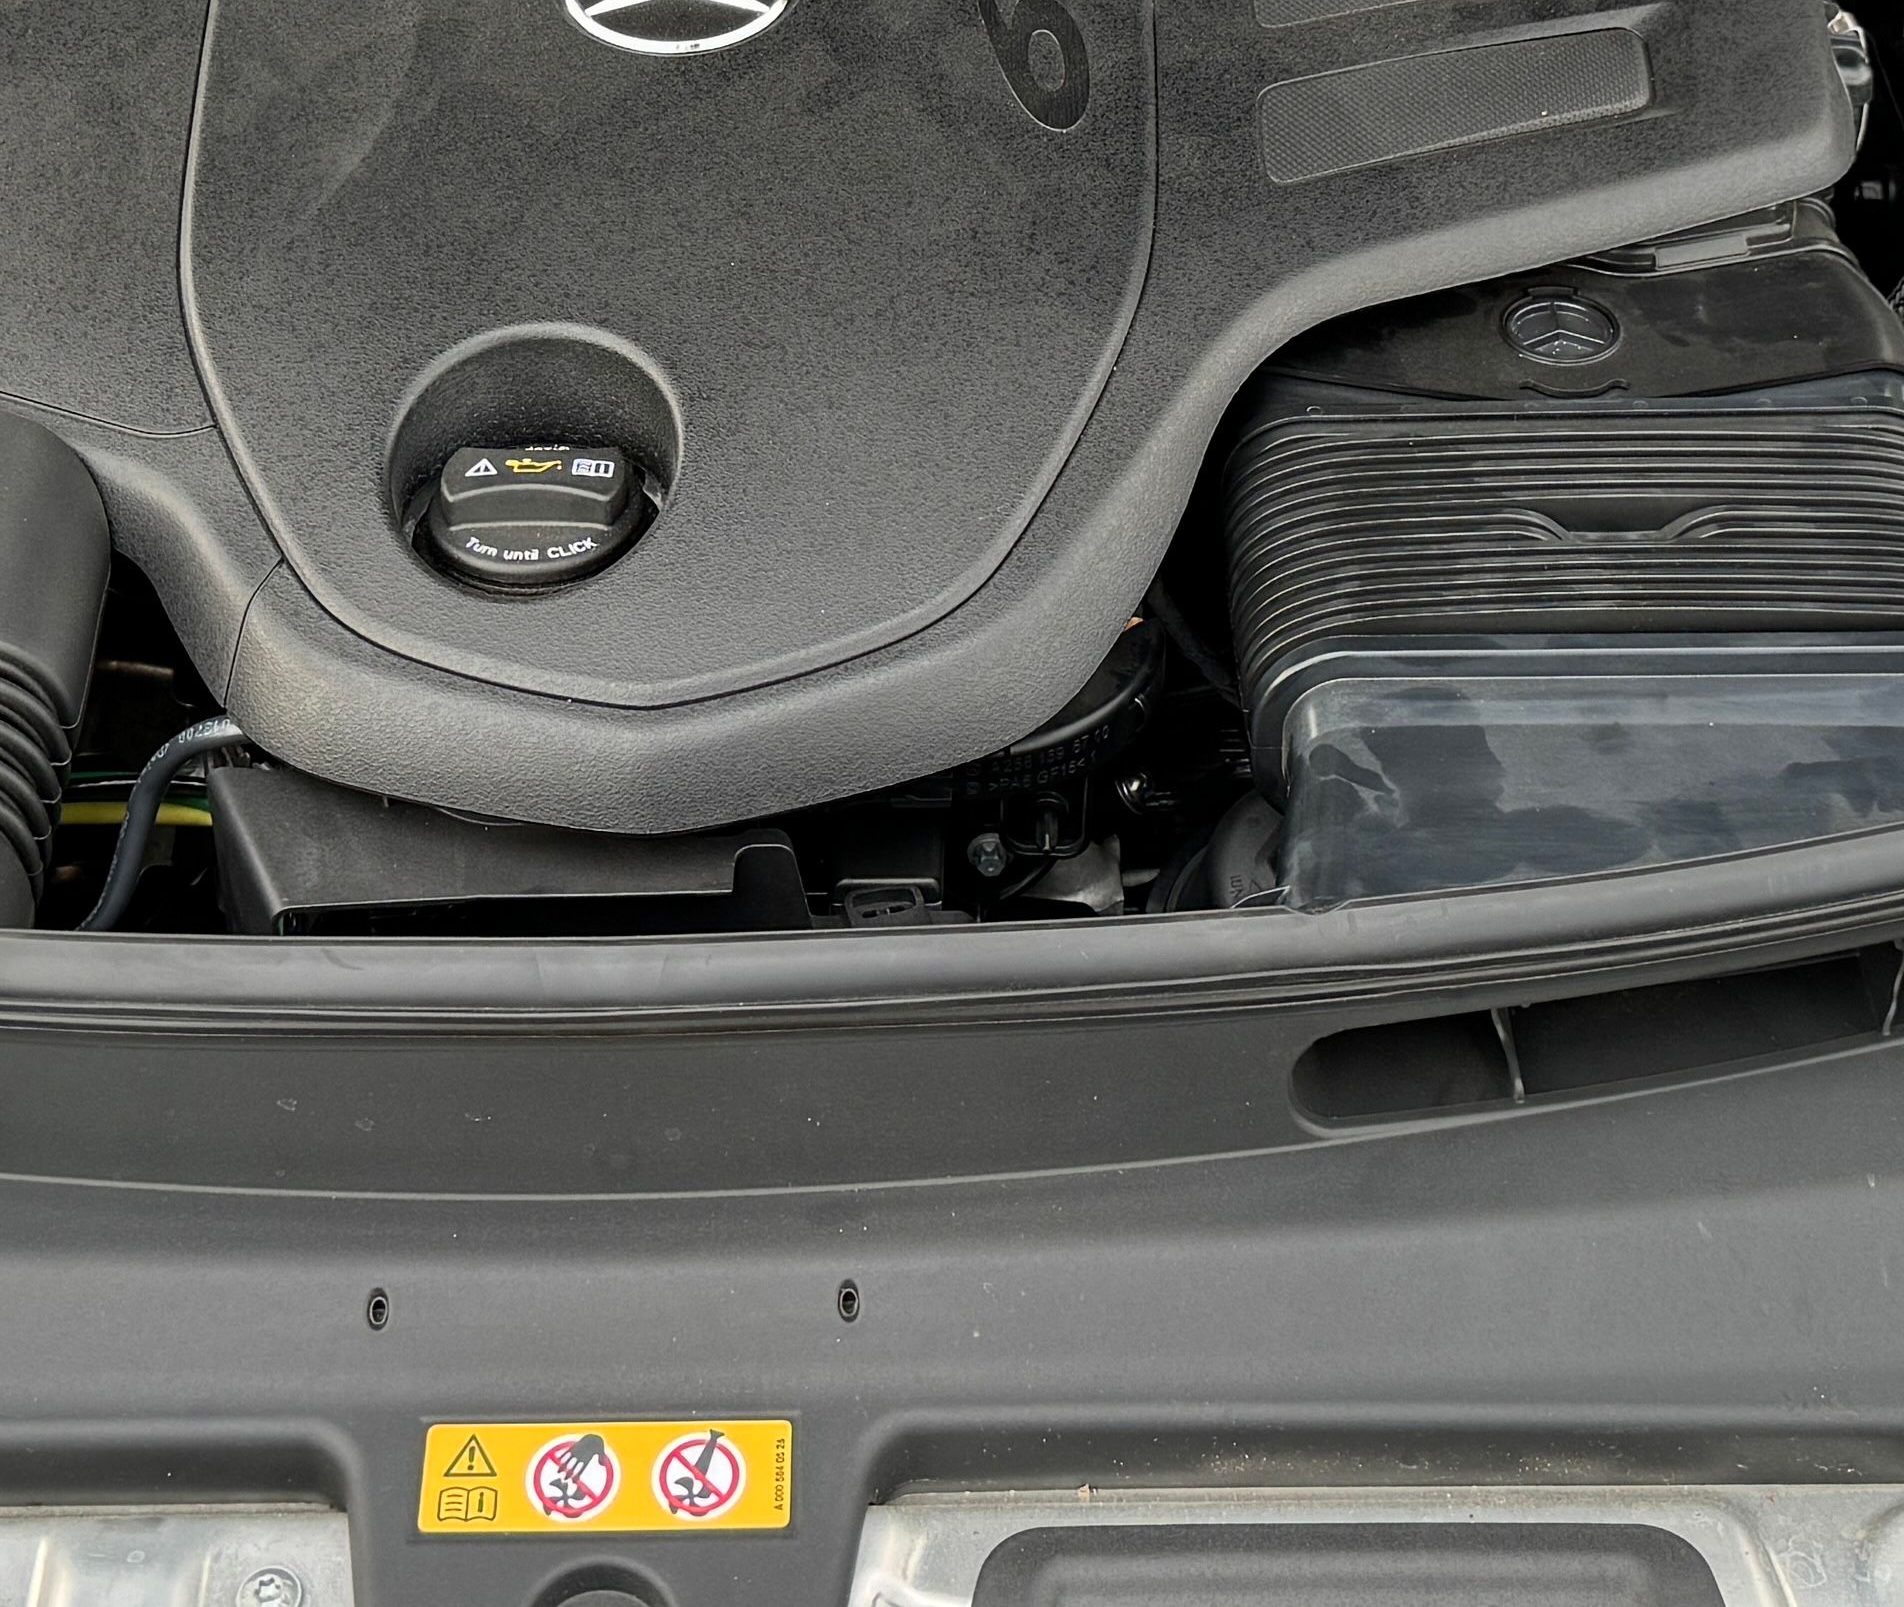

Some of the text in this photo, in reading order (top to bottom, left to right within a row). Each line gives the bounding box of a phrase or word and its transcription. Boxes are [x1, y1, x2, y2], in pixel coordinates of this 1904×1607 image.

[465, 536, 598, 561] Turn until CLICK
[774, 1503, 784, 1511] A
